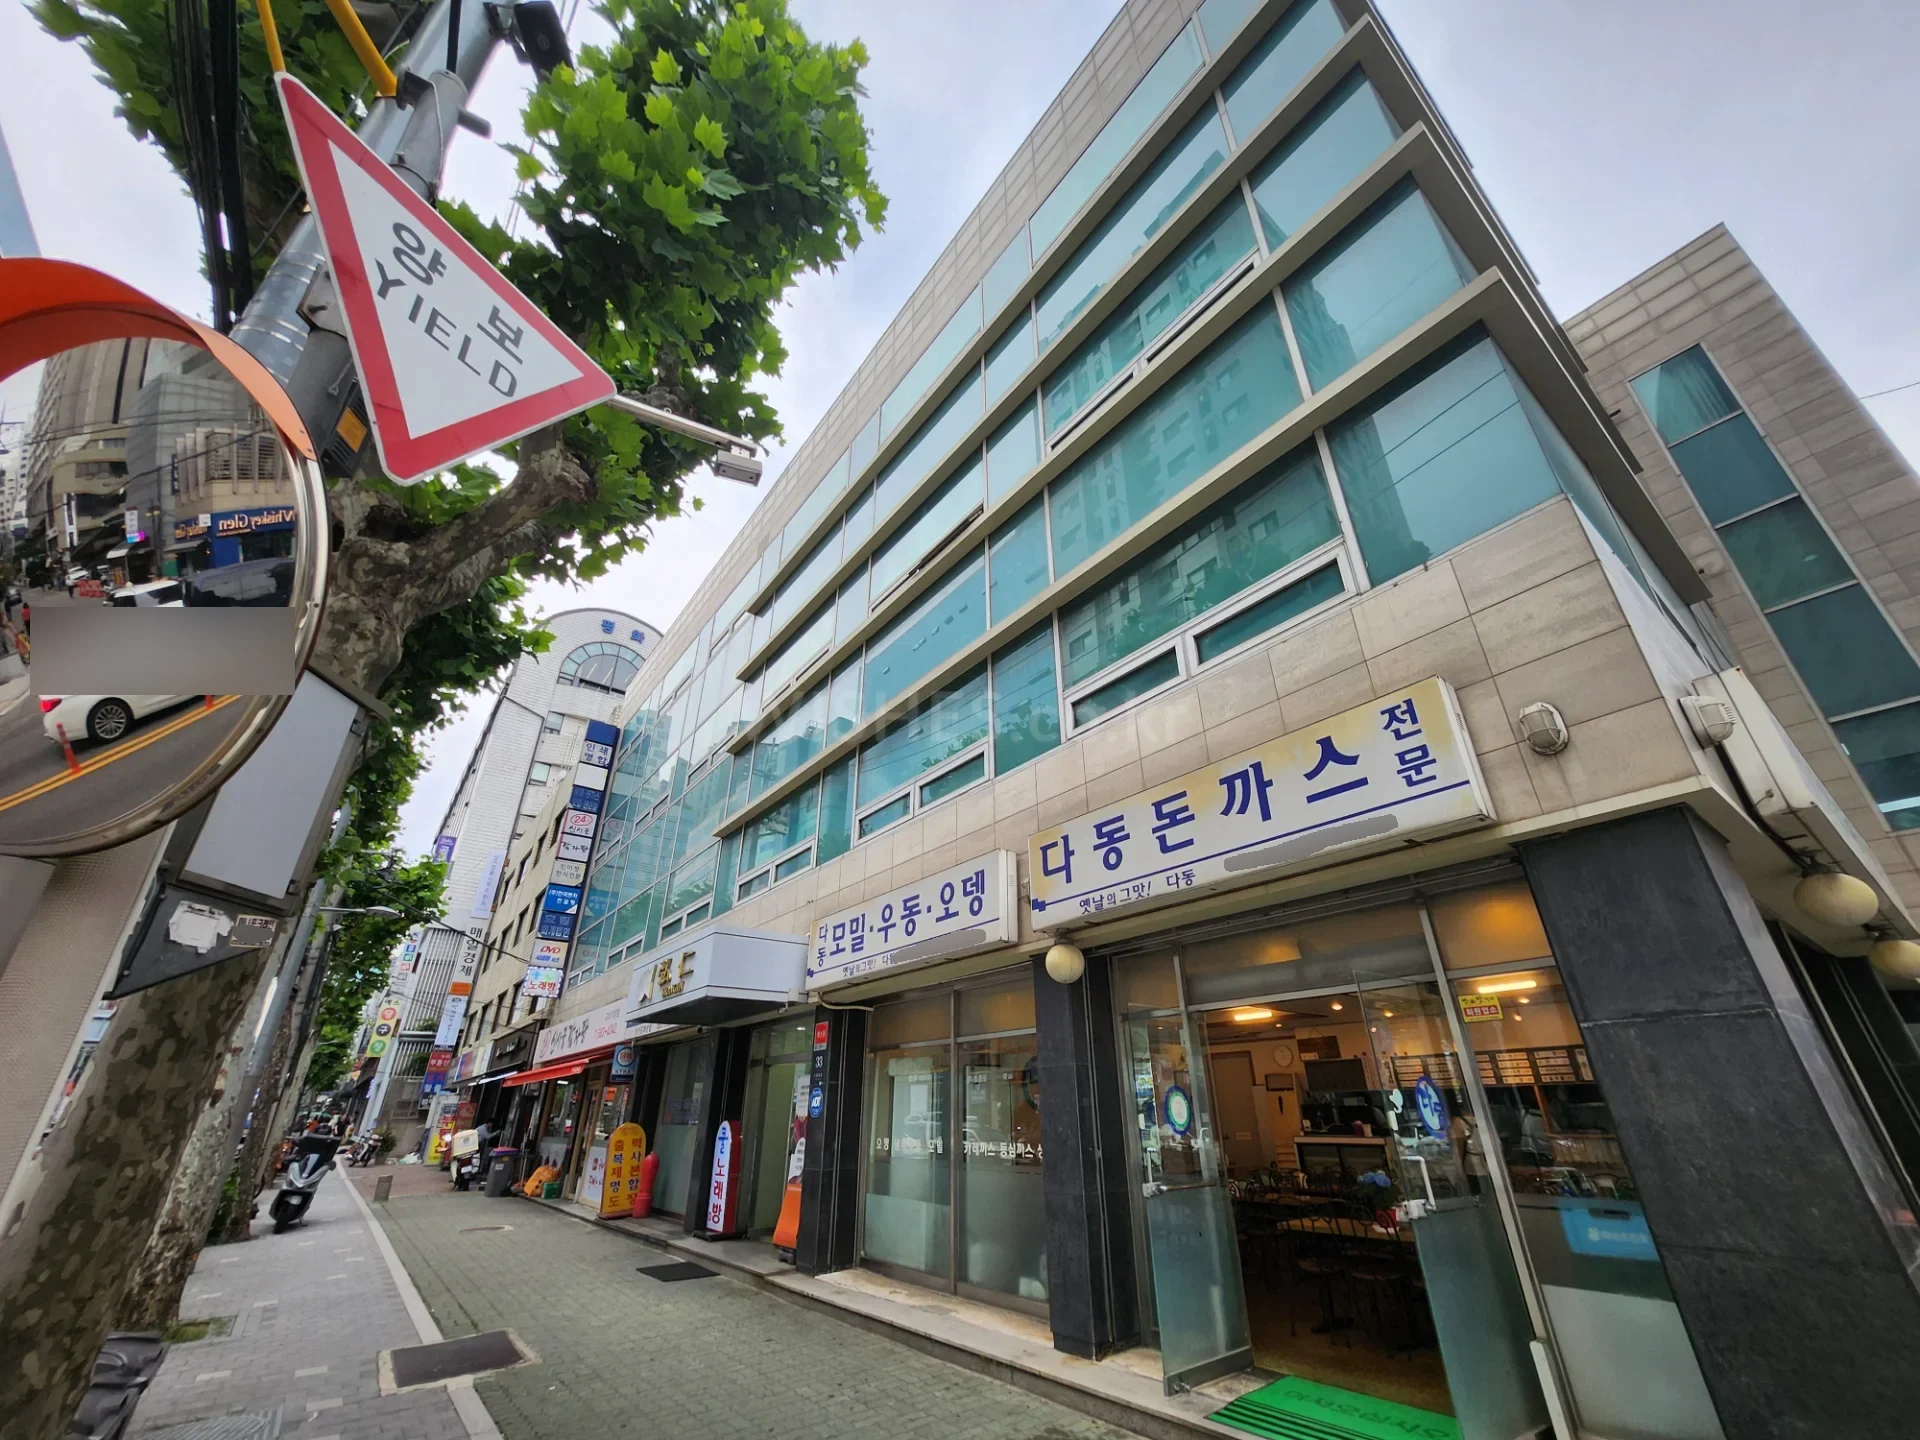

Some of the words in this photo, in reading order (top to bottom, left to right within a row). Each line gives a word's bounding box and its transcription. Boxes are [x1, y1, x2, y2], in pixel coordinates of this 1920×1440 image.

[373, 259, 518, 398] YIELD
[586, 743, 609, 755] 인쇄
[1380, 697, 1439, 787] 전문
[1040, 736, 1369, 884] 다동돈까스
[1165, 868, 1195, 889] 다동
[459, 926, 483, 977] 매일경제
[540, 945, 561, 955] DVD
[528, 980, 556, 991] 노래방
[815, 1056, 824, 1068] 33
[811, 1096, 821, 1108] ADT
[928, 1138, 943, 1153] 모밀
[963, 1141, 996, 1157] 카레까스
[711, 1158, 725, 1224] 노래방
